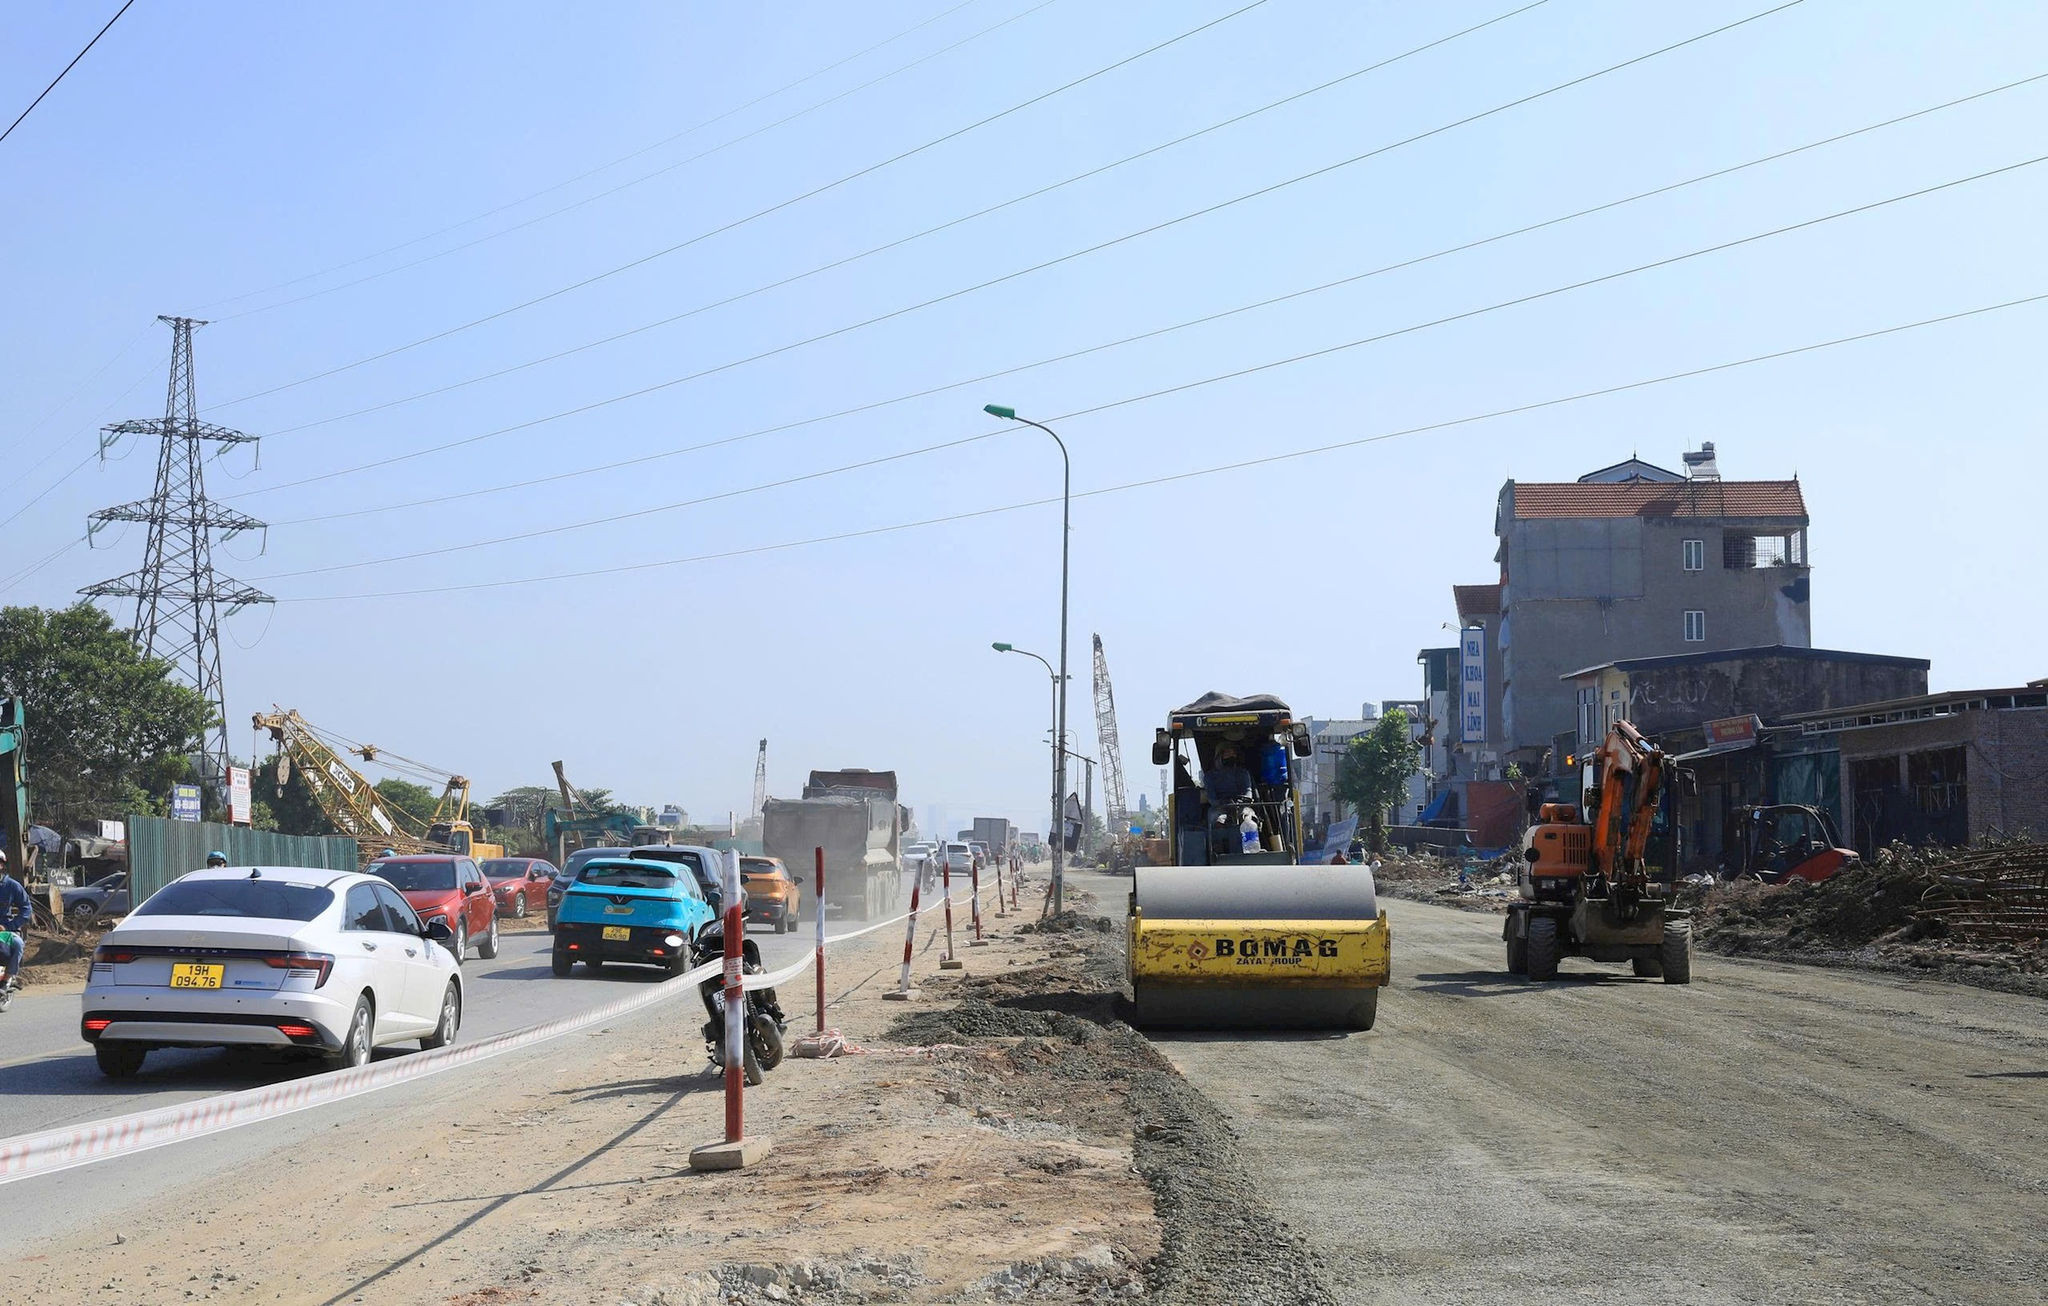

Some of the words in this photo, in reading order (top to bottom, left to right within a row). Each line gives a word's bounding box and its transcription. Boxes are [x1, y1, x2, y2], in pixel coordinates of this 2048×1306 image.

[1466, 640, 1480, 657] NHA
[1465, 665, 1482, 682] KHOA
[1467, 691, 1480, 708] MAI
[1215, 938, 1339, 958] BOMAG
[1270, 957, 1302, 965] ROUP
[188, 965, 210, 976] 19H
[175, 976, 217, 988] 094.76
